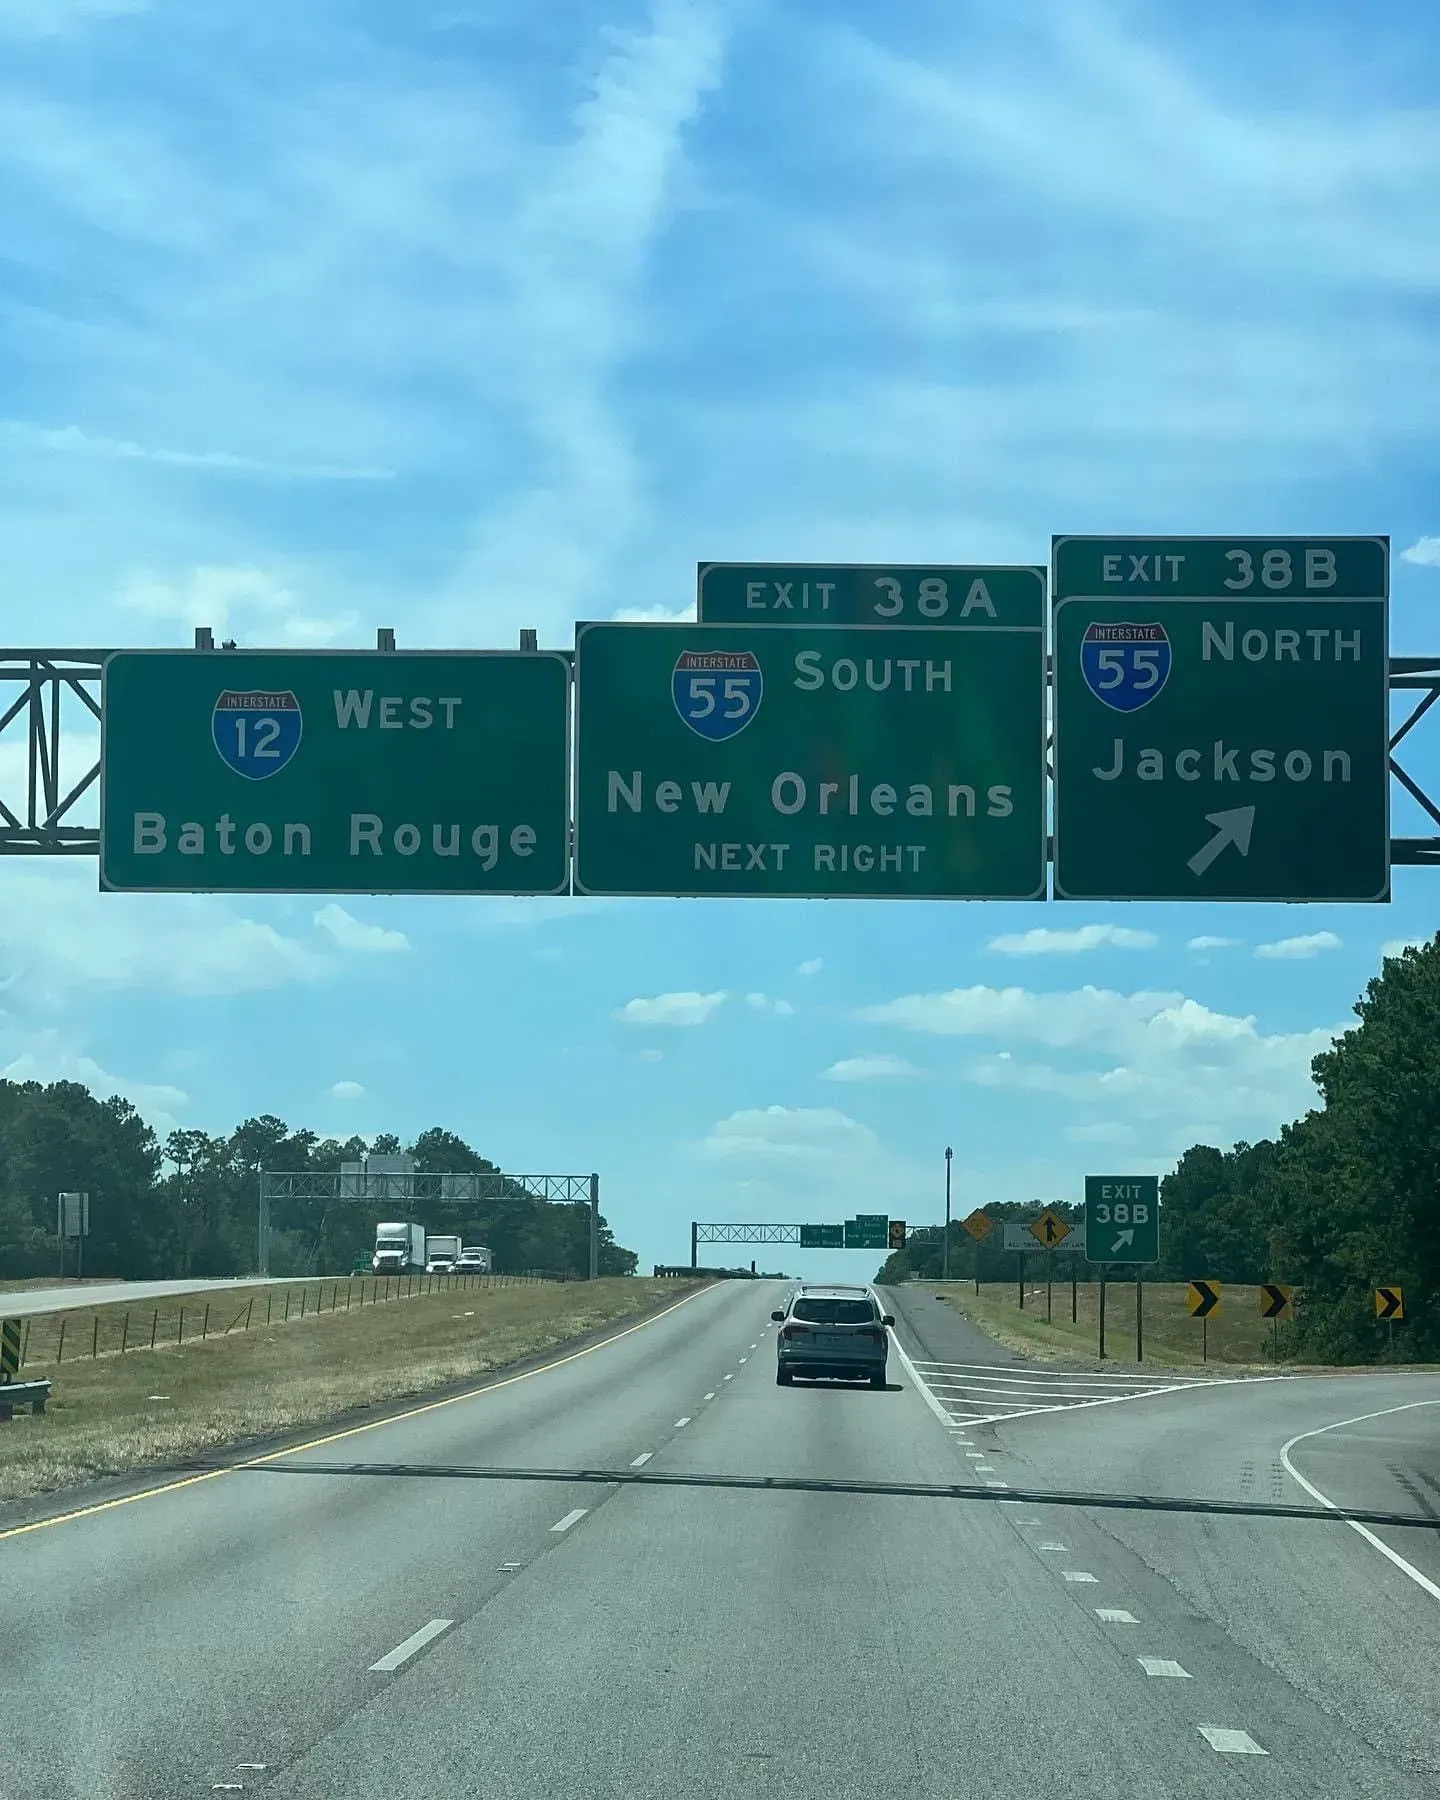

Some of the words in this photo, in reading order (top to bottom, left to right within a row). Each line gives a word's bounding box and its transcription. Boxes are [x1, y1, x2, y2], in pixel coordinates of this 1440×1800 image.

[1102, 554, 1186, 582] EXIT
[1223, 548, 1338, 590] 38B
[746, 582, 837, 610] EXIT
[873, 576, 998, 618] 38A
[1095, 628, 1156, 640] INTERSTATE
[1202, 621, 1361, 662] NORTH
[686, 656, 748, 669] INTERSTATE
[793, 650, 952, 692] SOUTH
[1098, 649, 1159, 690] 55
[226, 695, 288, 708] INTERSTATE
[333, 689, 462, 729] WEST
[688, 678, 751, 719] 55
[235, 717, 281, 758] 12
[1091, 738, 1351, 782] Jackson
[607, 770, 732, 814] New
[771, 771, 1014, 817] Orleans
[133, 812, 311, 856] Baton
[350, 813, 537, 872] Rouge
[694, 843, 790, 871] NEXT
[814, 844, 926, 873] RIGHT
[1101, 1184, 1142, 1199] EXIT
[1096, 1203, 1149, 1224] 38B
